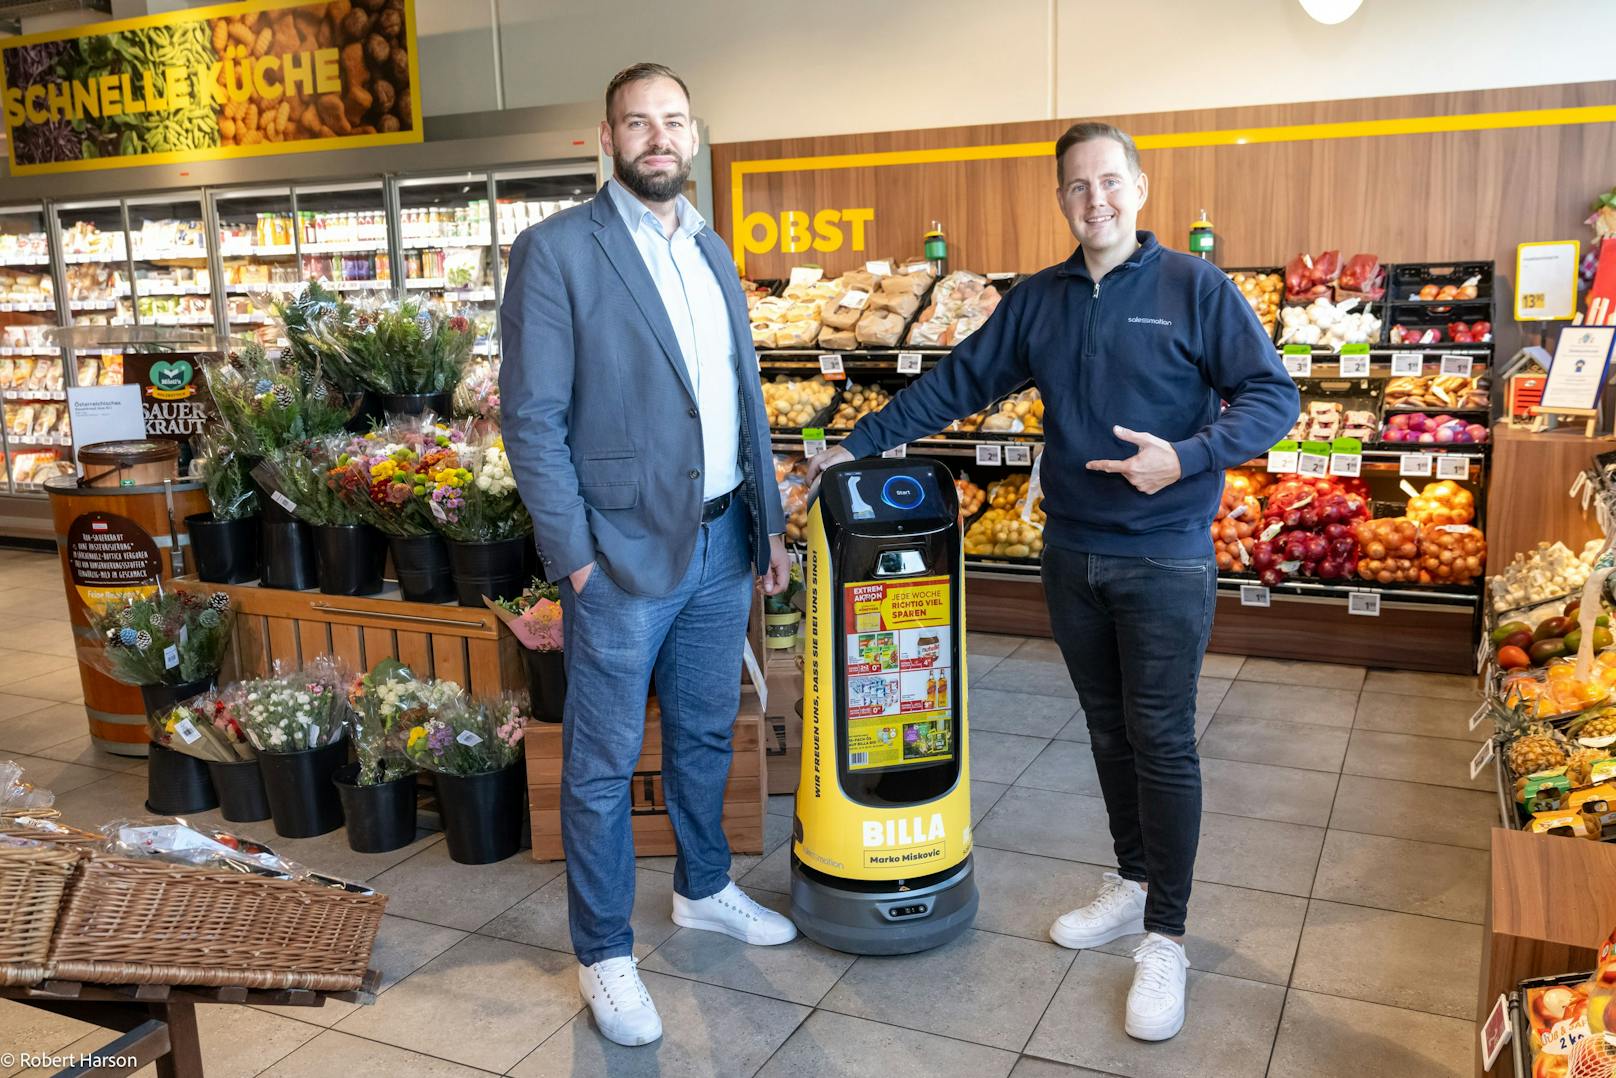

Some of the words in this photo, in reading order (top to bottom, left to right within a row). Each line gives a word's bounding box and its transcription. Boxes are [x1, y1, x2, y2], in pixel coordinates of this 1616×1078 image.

[7, 64, 191, 128] SCHNELLE
[199, 43, 343, 107] KÜCHE
[744, 208, 875, 254] OBST
[142, 402, 208, 420] SAUER
[145, 418, 207, 435] KRAUT
[853, 585, 883, 595] EXTREM
[892, 592, 910, 600] JEDE
[911, 590, 941, 599] WOCHE
[892, 600, 924, 609] RICHTIG
[925, 598, 943, 606] VIEL
[892, 609, 927, 619] SPAREN
[863, 813, 945, 847] BILLA
[870, 855, 900, 864] Marko
[902, 848, 940, 862] Miskovic
[1560, 1037, 1567, 1049] 2
